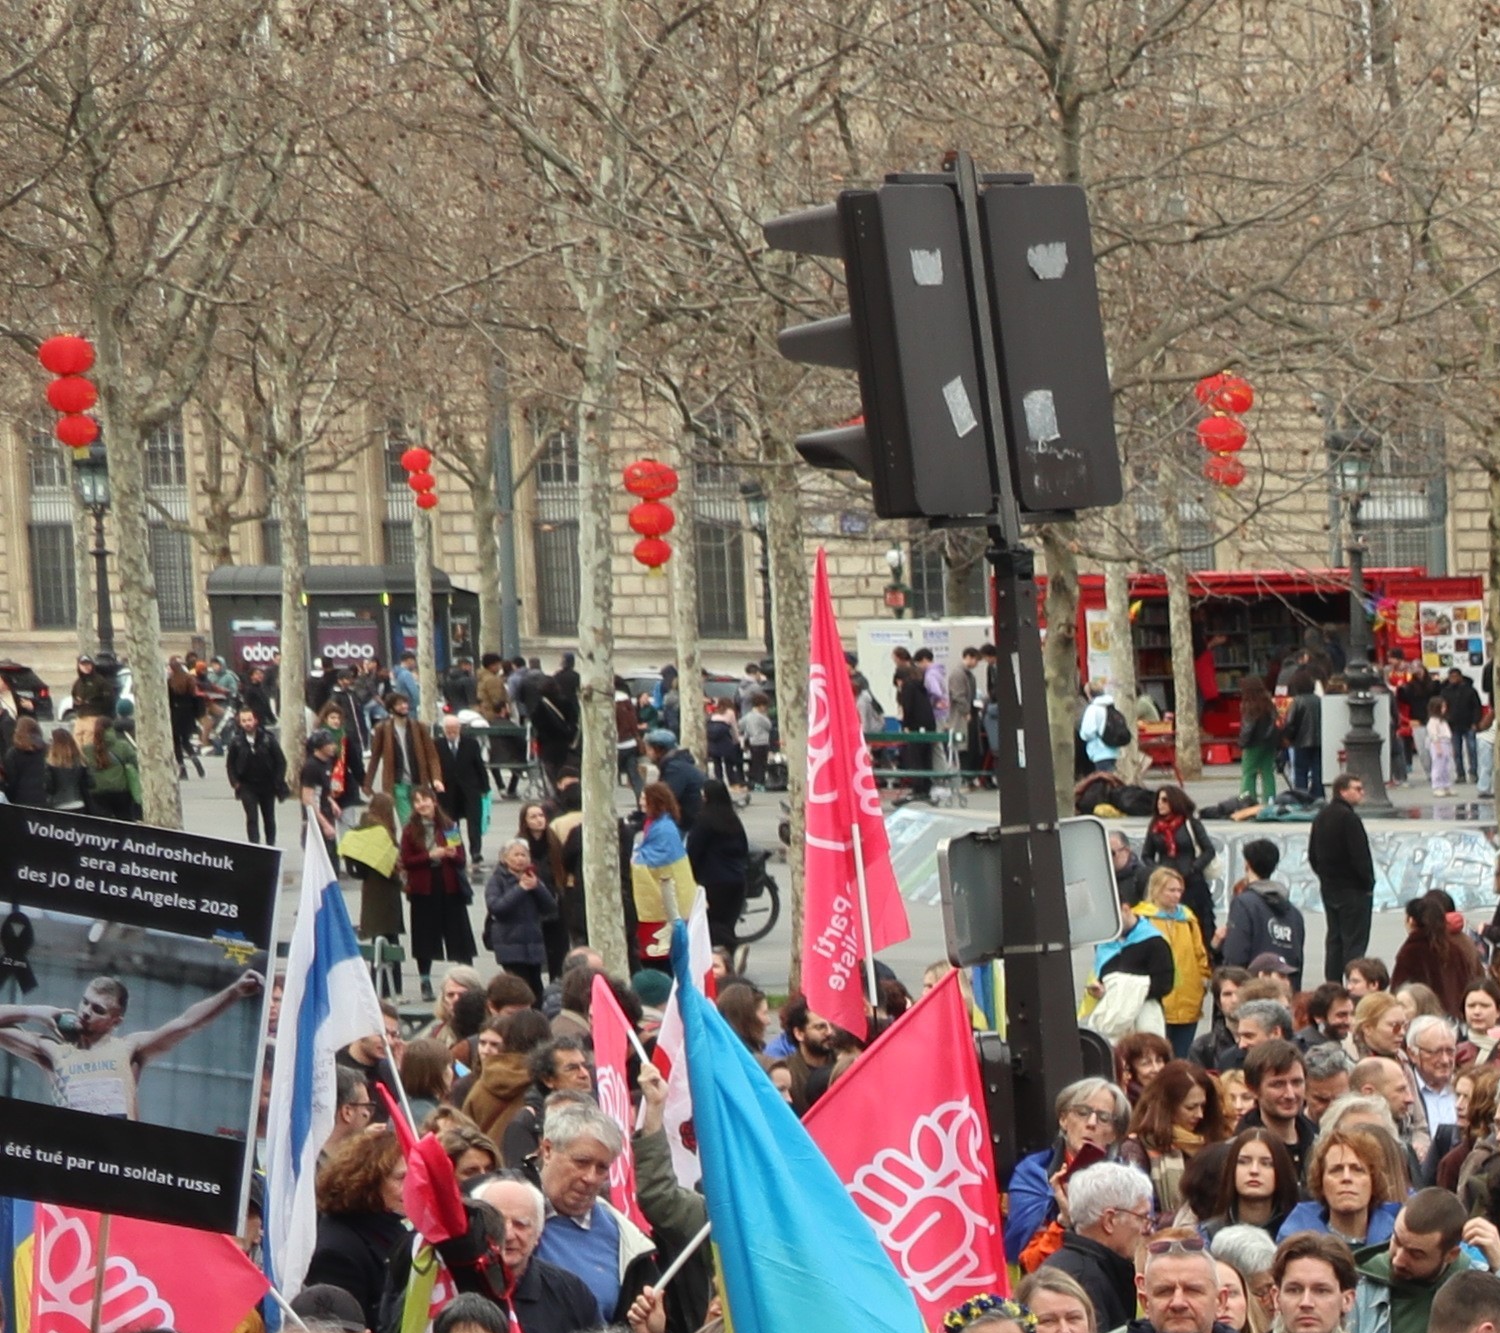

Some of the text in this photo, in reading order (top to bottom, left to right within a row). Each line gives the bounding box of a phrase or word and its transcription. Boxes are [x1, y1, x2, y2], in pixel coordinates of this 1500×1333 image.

[323, 640, 375, 659] odoo
[27, 820, 234, 872] Volodymyr Androshchuk
[80, 854, 178, 884] sera absent
[18, 865, 240, 919] des JO de Los Angeles 2028
[4, 1141, 222, 1196] été tué par un soldat russe
